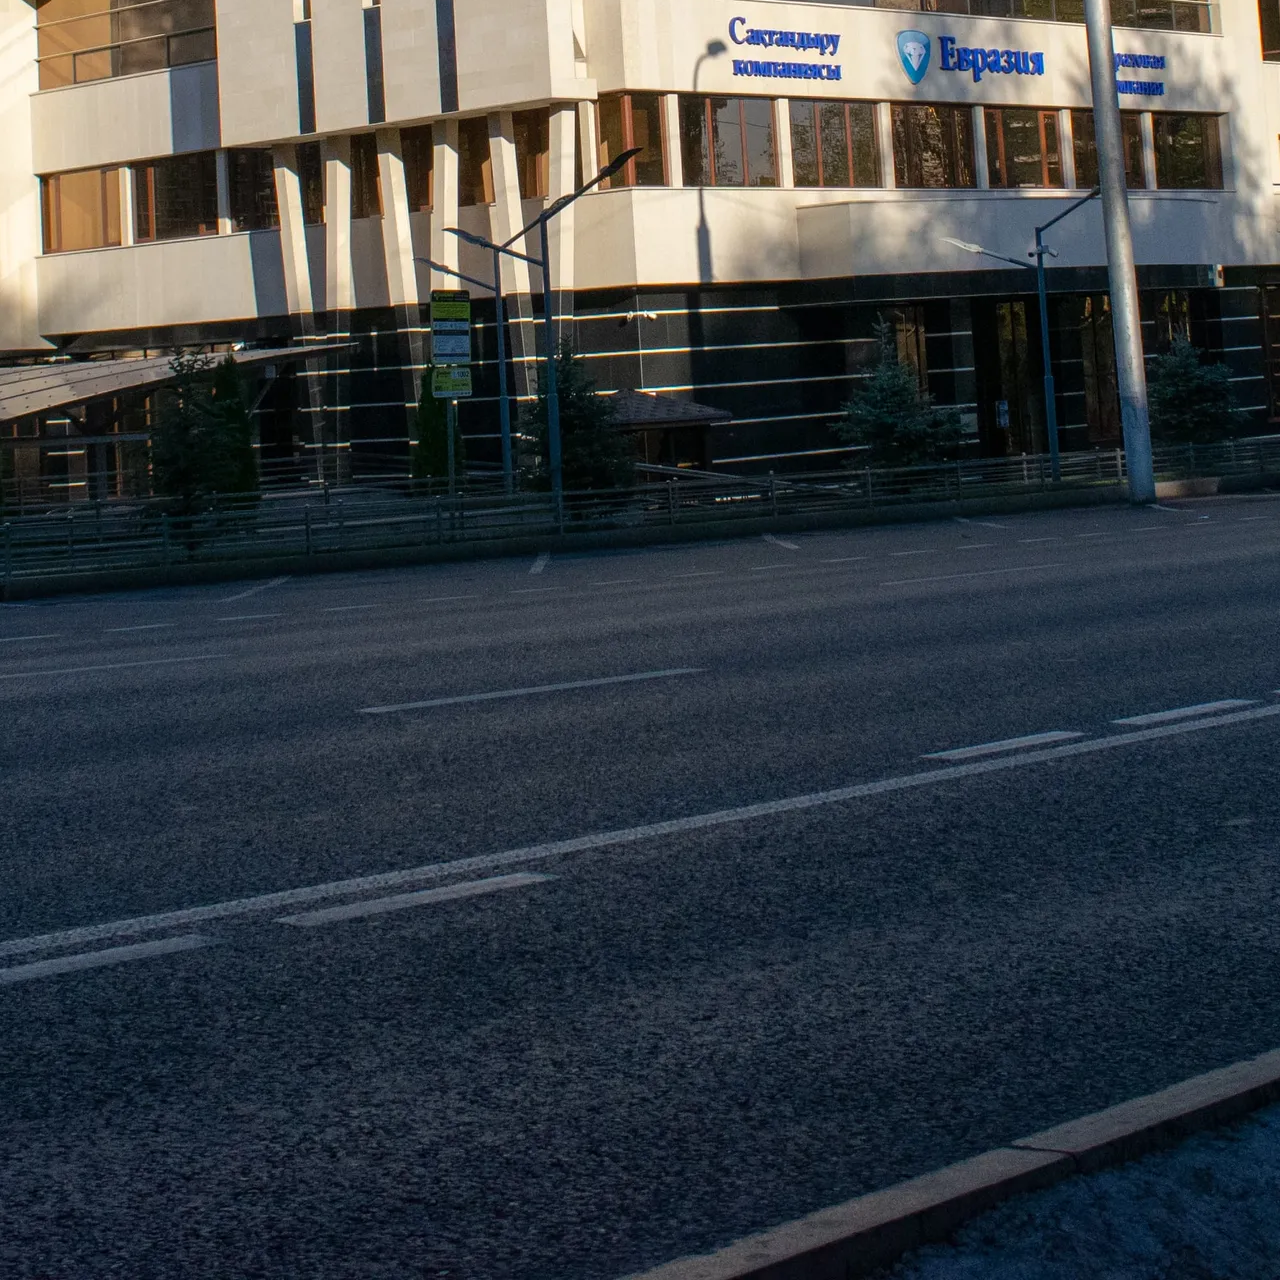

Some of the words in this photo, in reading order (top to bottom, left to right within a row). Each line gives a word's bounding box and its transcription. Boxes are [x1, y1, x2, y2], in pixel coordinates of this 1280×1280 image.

[728, 16, 841, 56] Сақтандыру
[732, 59, 842, 80] компаниясы
[937, 35, 1044, 83] Евразия
